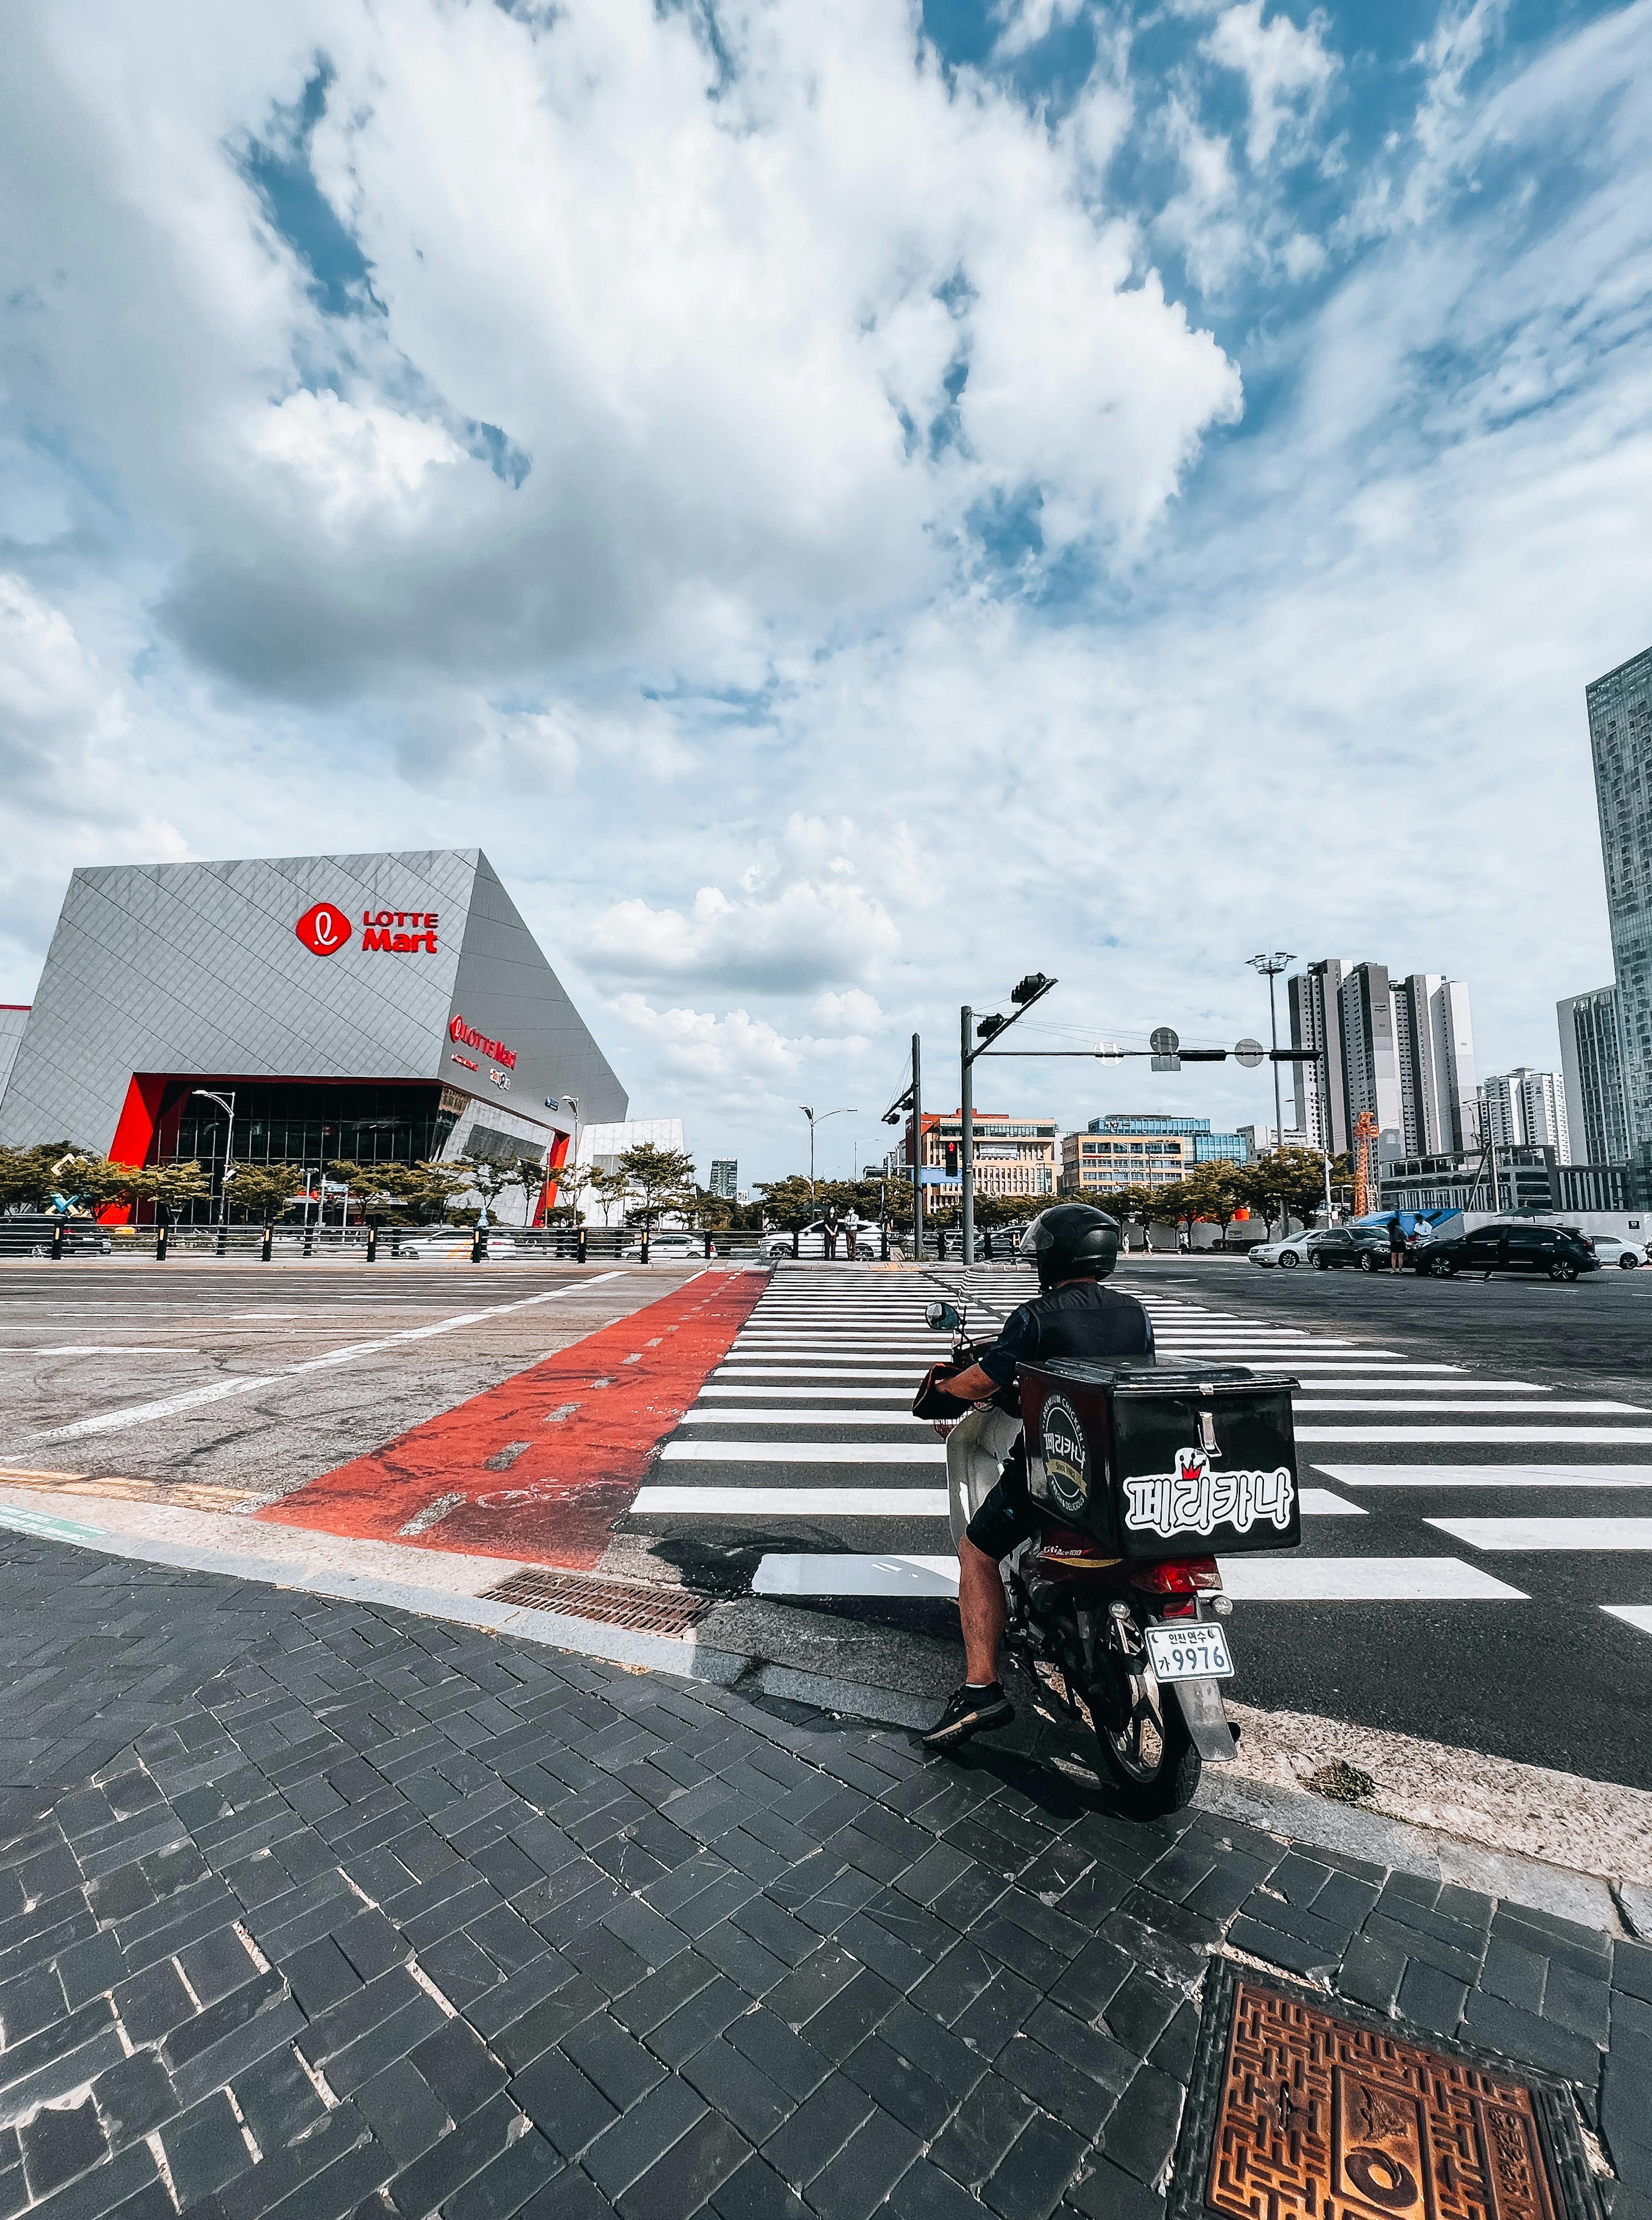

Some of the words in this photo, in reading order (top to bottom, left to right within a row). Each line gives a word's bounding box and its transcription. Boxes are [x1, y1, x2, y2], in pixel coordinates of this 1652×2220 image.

[363, 911, 439, 929] LOTTE
[362, 928, 438, 954] Mart
[1062, 1398, 1083, 1441] CHICKEN
[1043, 1433, 1086, 1469] 페리카나
[1127, 1472, 1290, 1533] 페리카나
[1172, 1646, 1225, 1671] 9976
